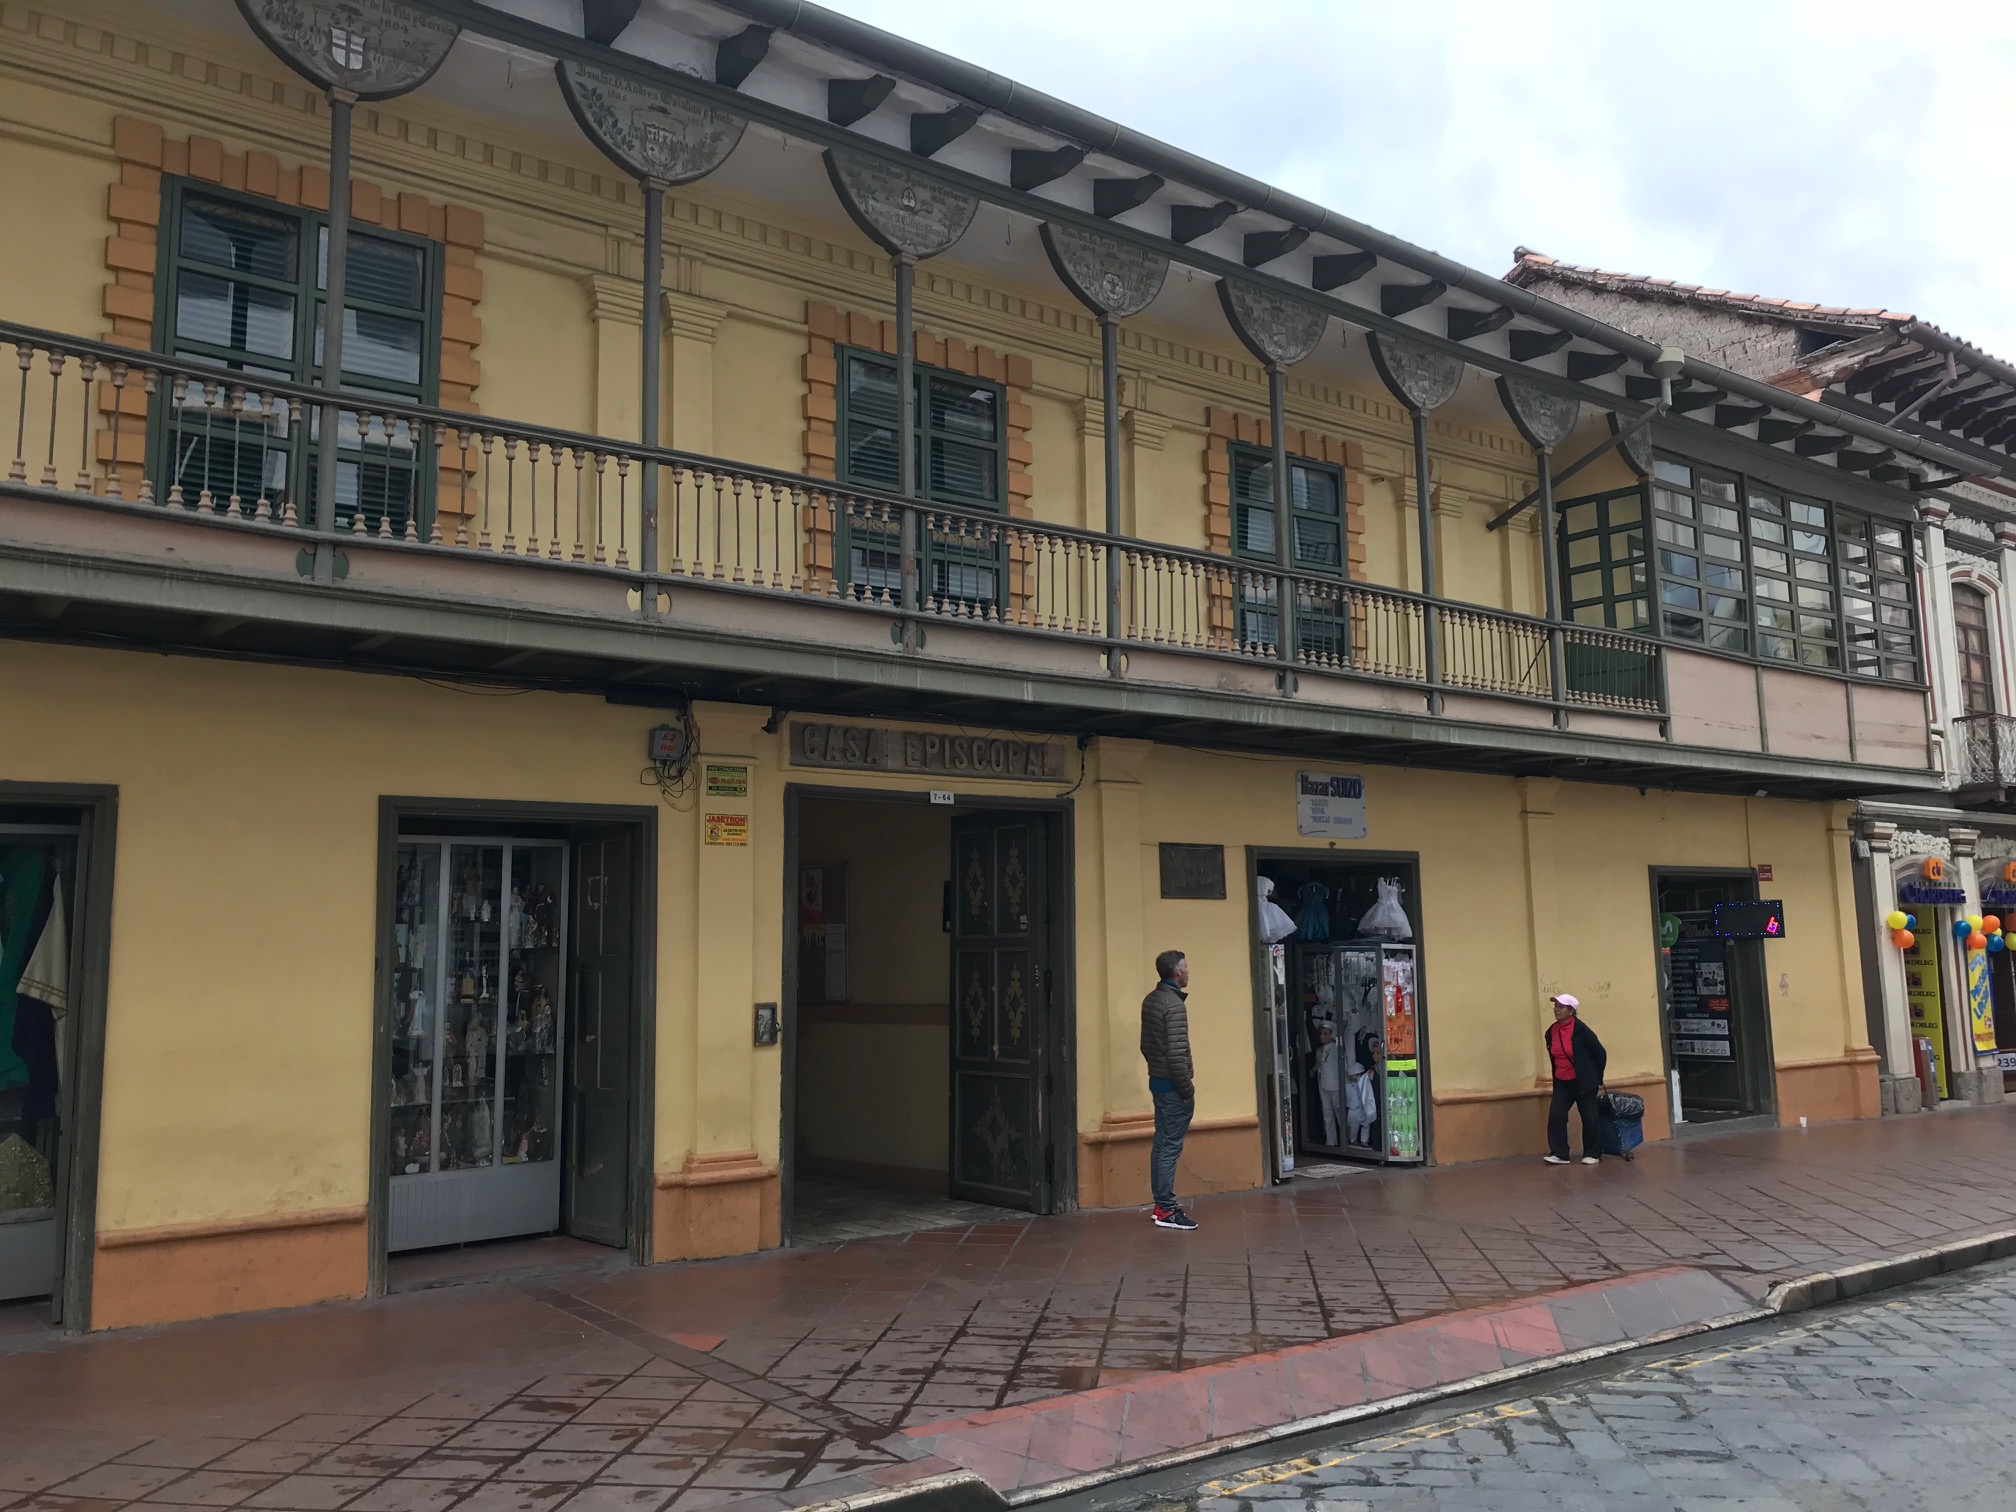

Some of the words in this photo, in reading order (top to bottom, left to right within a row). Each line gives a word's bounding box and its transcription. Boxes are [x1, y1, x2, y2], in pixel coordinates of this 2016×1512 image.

[800, 722, 882, 766] CASA
[904, 732, 1058, 778] EPISCOPAL
[933, 793, 951, 801] 7-64
[1300, 774, 1330, 797] Bazar
[1330, 776, 1363, 799] SUIZO
